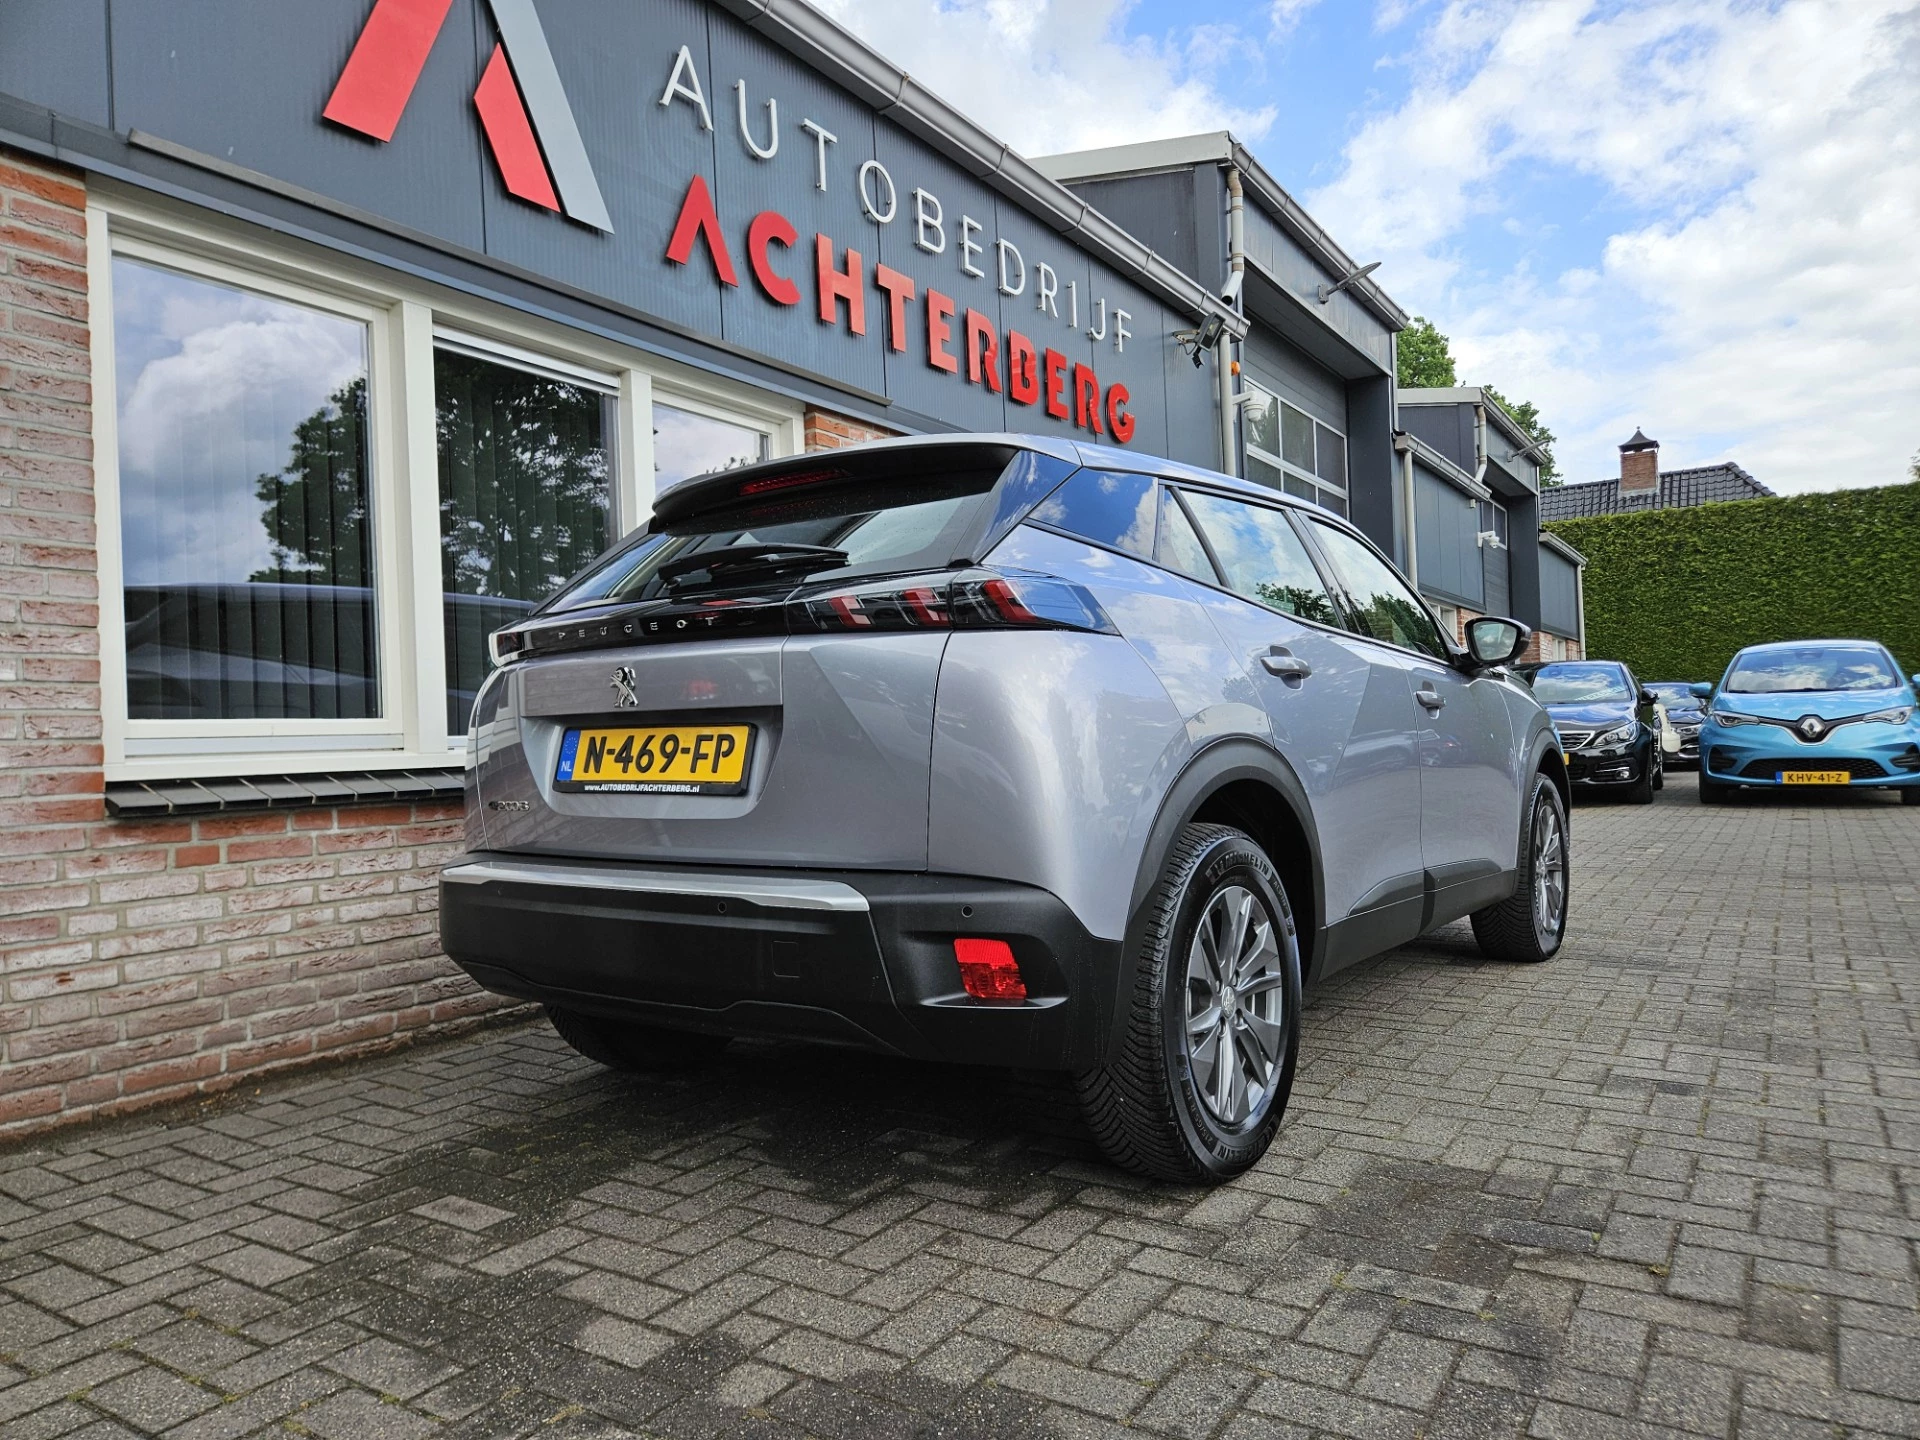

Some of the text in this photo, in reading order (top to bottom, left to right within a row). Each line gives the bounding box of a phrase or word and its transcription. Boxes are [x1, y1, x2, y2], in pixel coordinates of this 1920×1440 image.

[659, 45, 1132, 352] AUTOBEDRIJF
[666, 175, 1136, 444] ACHTERBERG
[558, 617, 715, 639] PEUGEOT
[583, 734, 736, 774] N-469-FP
[560, 761, 572, 772] NL
[584, 783, 700, 794] www.AUTOBEDRIJFACHTERBERG.nl
[1787, 773, 1843, 783] KHV-41-Z
